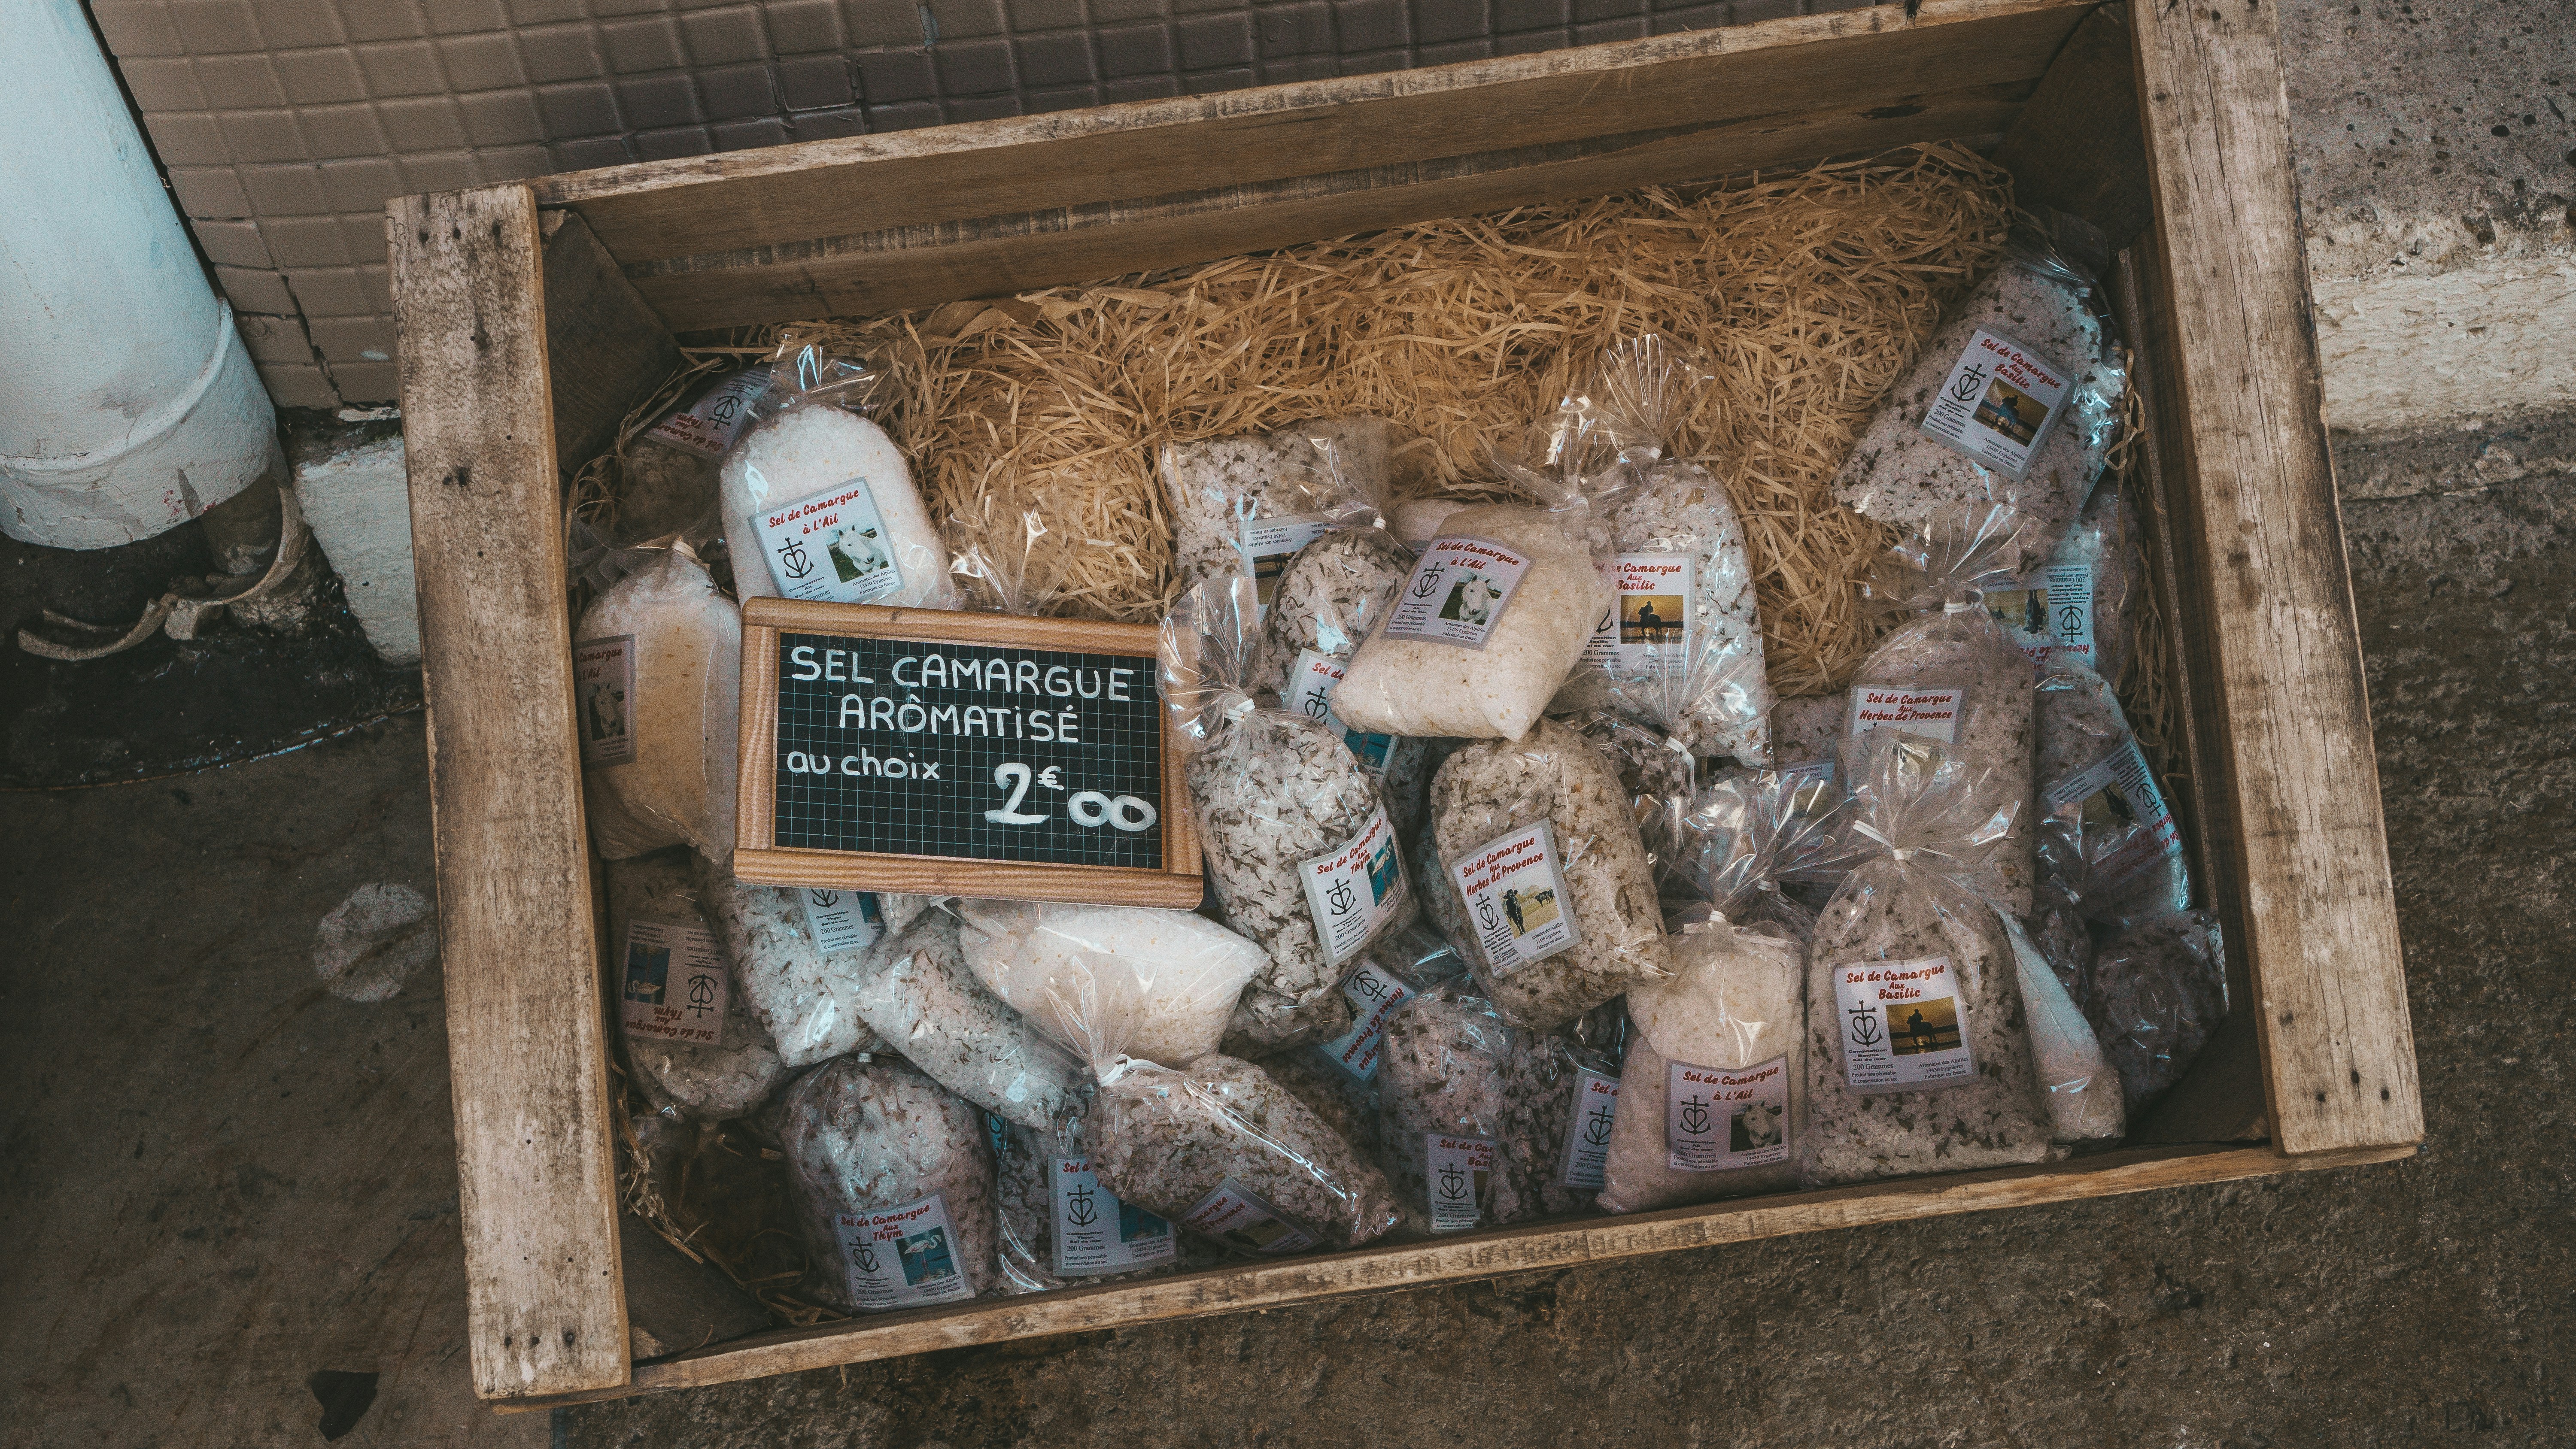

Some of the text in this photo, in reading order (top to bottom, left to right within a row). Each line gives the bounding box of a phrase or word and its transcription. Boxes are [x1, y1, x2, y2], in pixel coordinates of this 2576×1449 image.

[1981, 338, 2061, 388] Sel de Camargue
[2009, 364, 2024, 374] Aux
[1995, 363, 2031, 389] Basilic
[1944, 414, 1966, 427] Grammes
[769, 490, 859, 528] Sel de Camargue
[803, 513, 838, 534] à L'Ail
[1436, 542, 1519, 566] Sel de Camargue
[1450, 557, 1487, 570] à L'Ail
[1624, 563, 1681, 576] Camargue
[853, 576, 872, 586] Aromates
[791, 646, 1134, 702] SEL CAMARGUE
[1312, 663, 1331, 675] Sel
[1867, 693, 1952, 706] Sel de Camargue
[1859, 710, 1952, 721] Herbes de Provence
[787, 747, 939, 780] au choix
[1357, 848, 1367, 861] Aux
[1463, 837, 1535, 878] Sel de Camargue
[1317, 862, 1334, 875] Sel
[1337, 856, 1347, 868] de
[1351, 853, 1371, 875] Thym
[1489, 863, 1500, 873] Aux
[1466, 852, 1543, 897] Herbes de Provence
[1335, 919, 1365, 941] 200 Grammes
[1846, 964, 1944, 983] Sel de Camargue
[1878, 988, 1920, 1000] Basilic
[654, 1006, 683, 1020] Thym
[625, 1019, 714, 1040] Sel de Camargue
[1343, 987, 1405, 1064] Herbes de Provence
[1683, 1067, 1779, 1085] Sel de Camargue
[1591, 1082, 1610, 1094] Sel
[1713, 1088, 1753, 1100] à L'Ail
[1440, 1139, 1456, 1149] Sel
[1459, 1142, 1472, 1151] de
[1063, 1162, 1079, 1173] Sel
[841, 1204, 930, 1227] Sel de Camargue
[873, 1230, 903, 1242] Thym
